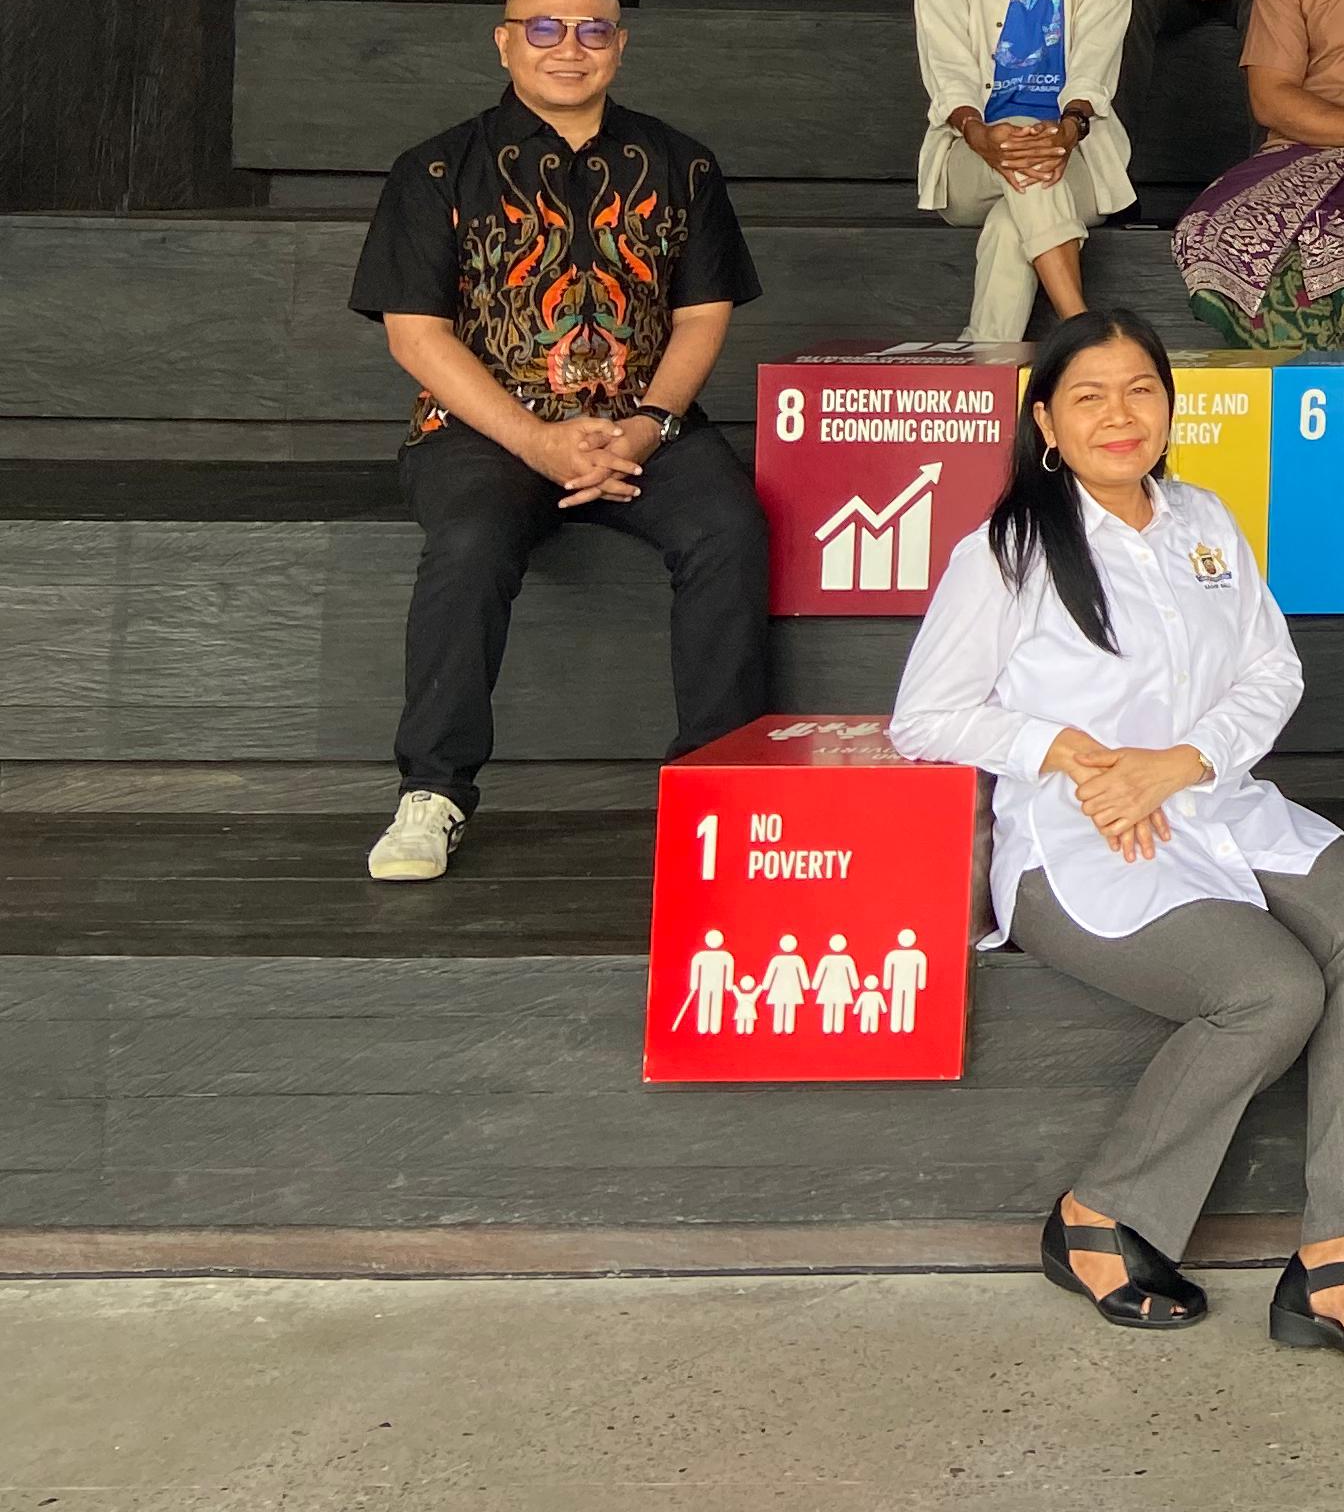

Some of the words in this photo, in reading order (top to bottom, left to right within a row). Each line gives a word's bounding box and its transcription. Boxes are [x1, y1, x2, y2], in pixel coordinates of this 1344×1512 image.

[775, 388, 805, 442] 8
[821, 389, 893, 414] DECENT
[895, 389, 952, 414] WORK
[955, 389, 994, 414] AND
[1174, 393, 1207, 415] BLE
[1211, 393, 1249, 415] AND
[1298, 388, 1327, 441] 6
[820, 418, 917, 443] ECONOMIC
[920, 418, 1001, 444] GROWTH
[1171, 422, 1222, 444] NERGY
[696, 815, 719, 880] 1
[750, 814, 783, 843] NO
[748, 849, 853, 880] POVERTY
